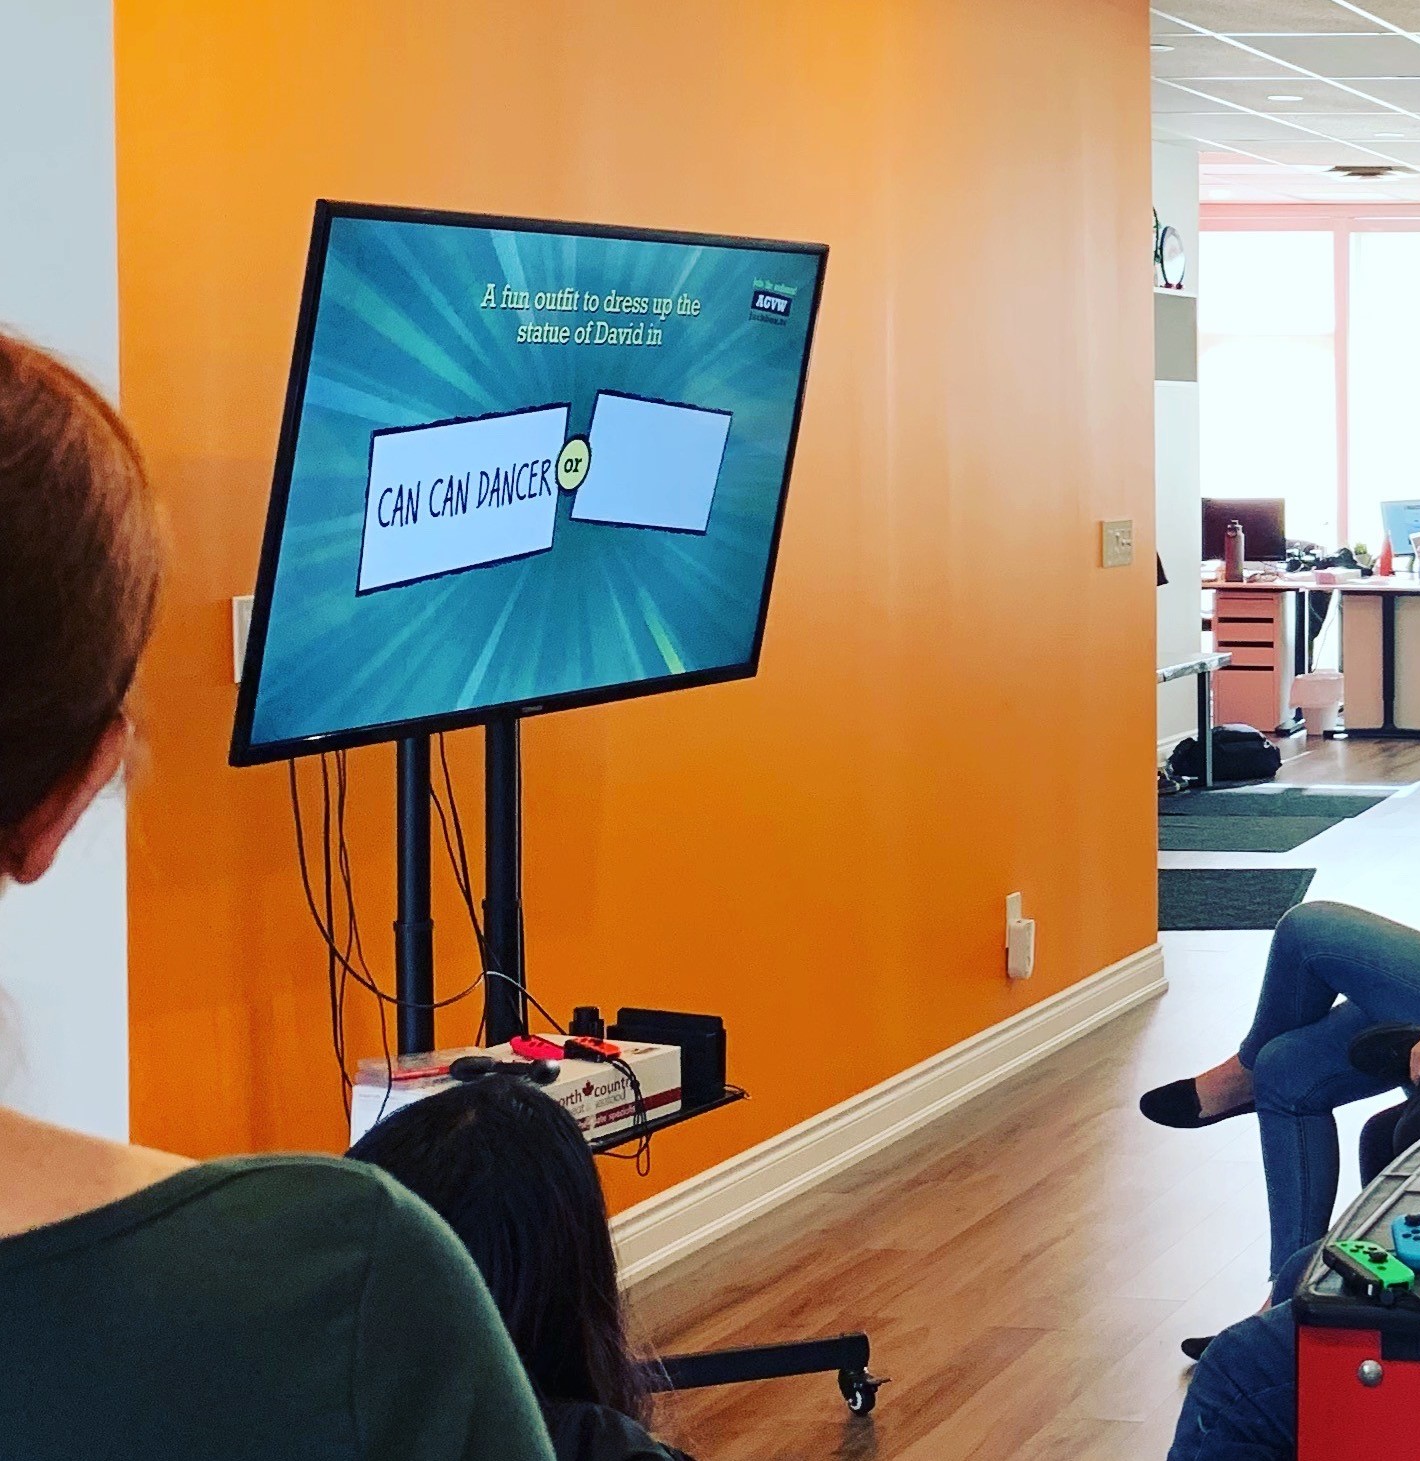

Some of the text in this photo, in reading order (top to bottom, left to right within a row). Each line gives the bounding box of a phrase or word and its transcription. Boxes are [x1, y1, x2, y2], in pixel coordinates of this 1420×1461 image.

[480, 283, 701, 321] A fun outfit to dress up the
[516, 320, 663, 346] statue of David in
[563, 457, 583, 473] or
[378, 459, 552, 528] CAN CAN DANCER
[560, 1077, 630, 1107] orth countr
